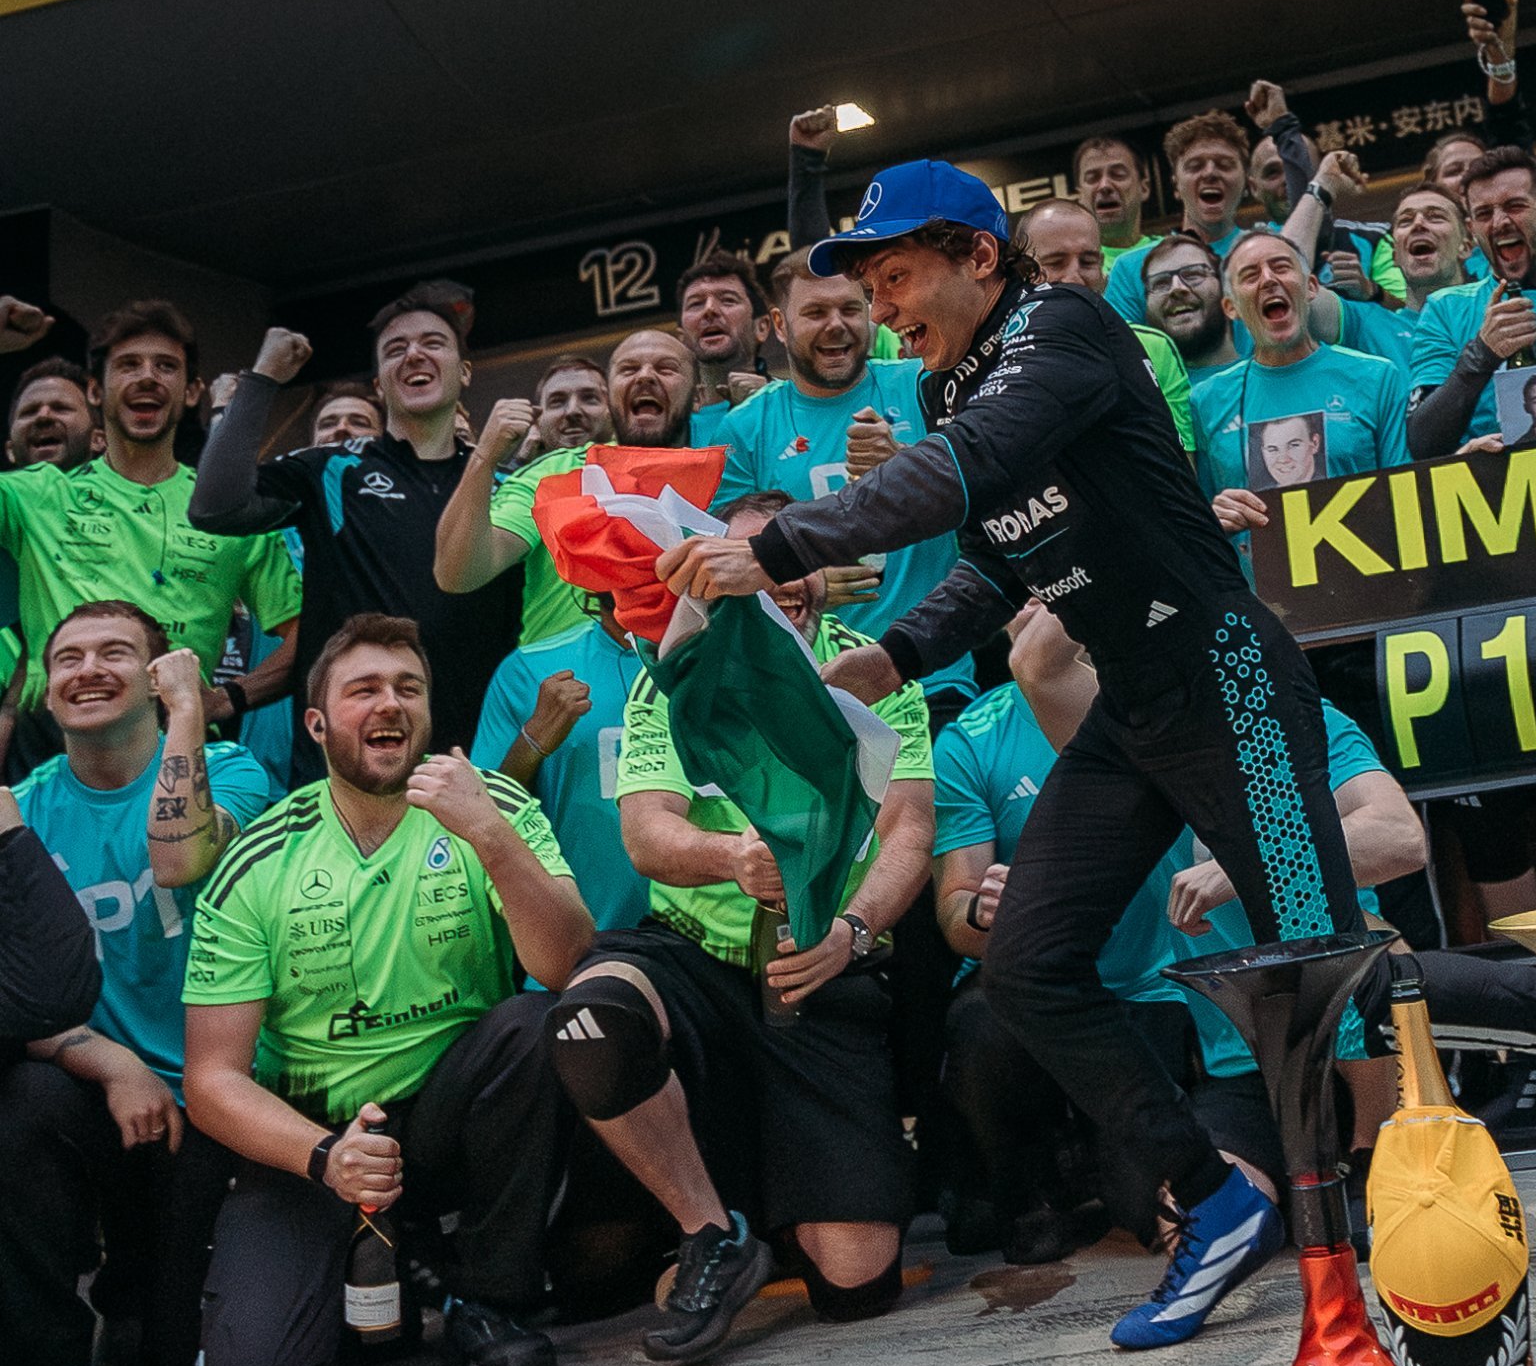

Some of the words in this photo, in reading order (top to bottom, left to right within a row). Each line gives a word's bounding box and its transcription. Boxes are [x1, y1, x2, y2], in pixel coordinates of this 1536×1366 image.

[579, 241, 661, 316] 12
[417, 883, 469, 907] INEOS
[310, 916, 346, 936] UBS
[428, 924, 471, 947] HPE
